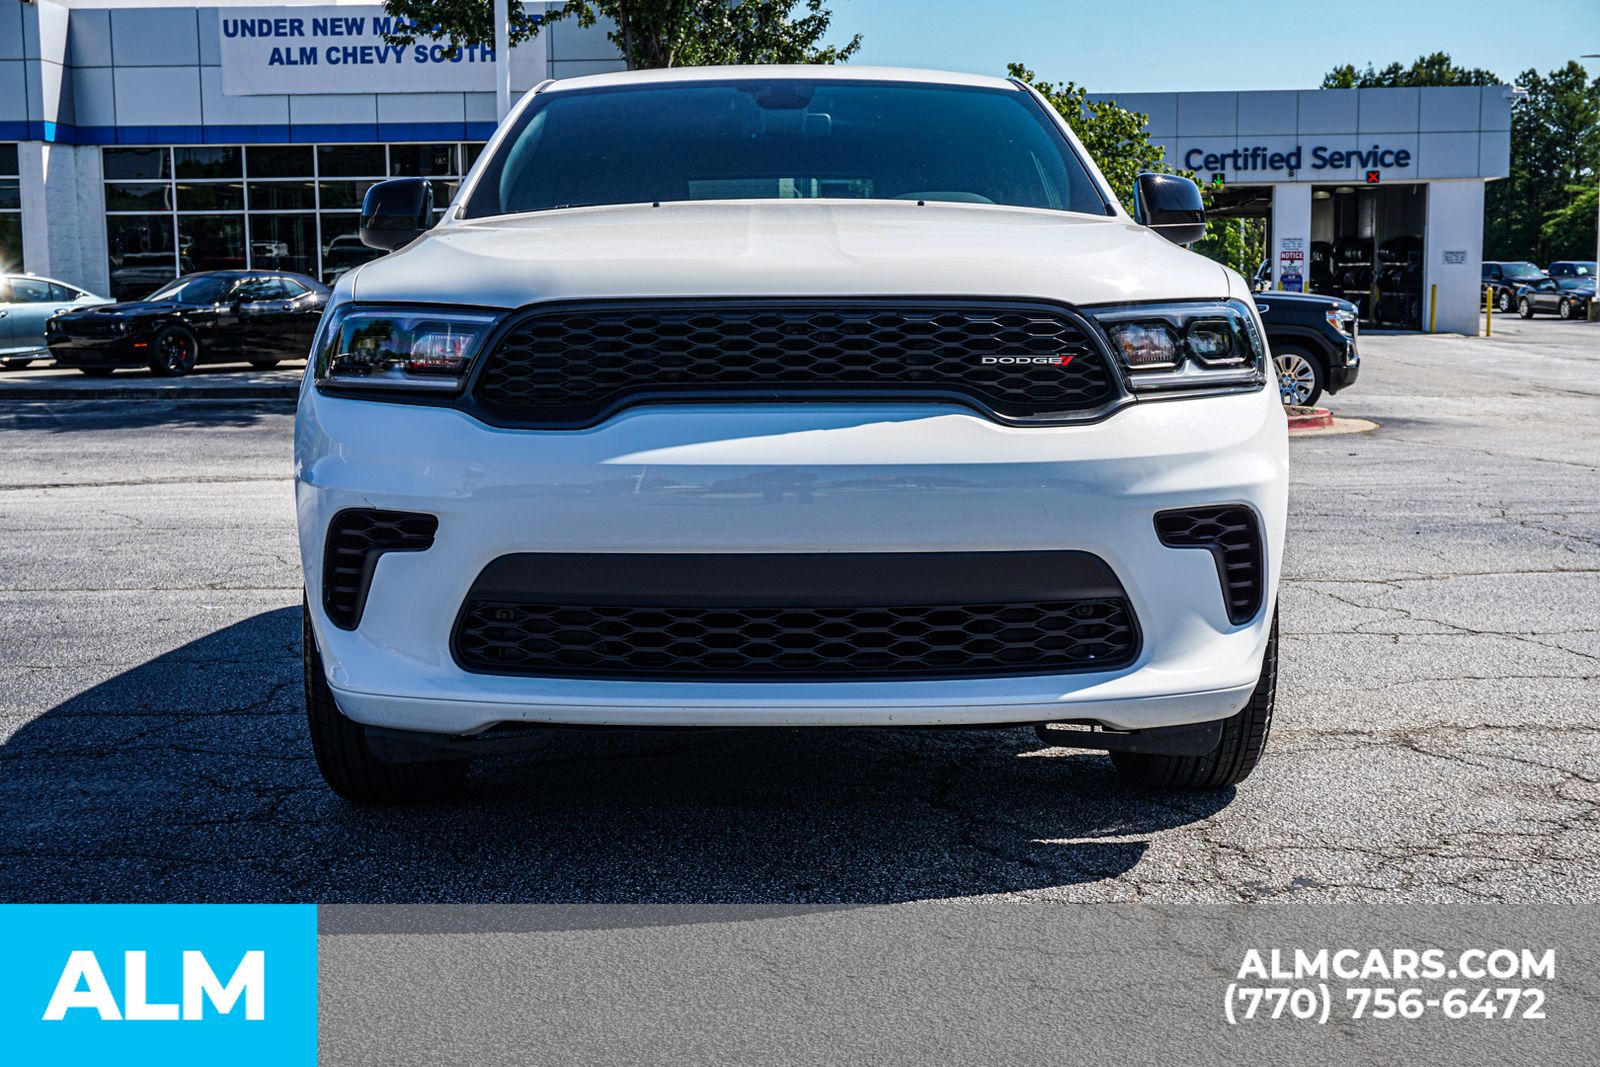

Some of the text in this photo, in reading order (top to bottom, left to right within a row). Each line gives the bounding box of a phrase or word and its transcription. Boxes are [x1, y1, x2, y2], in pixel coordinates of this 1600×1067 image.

[223, 18, 304, 37] UNDER
[312, 17, 365, 36] NEW
[268, 44, 496, 65] ALM CHEVY SOUTH
[1185, 145, 1410, 171] Certified Service
